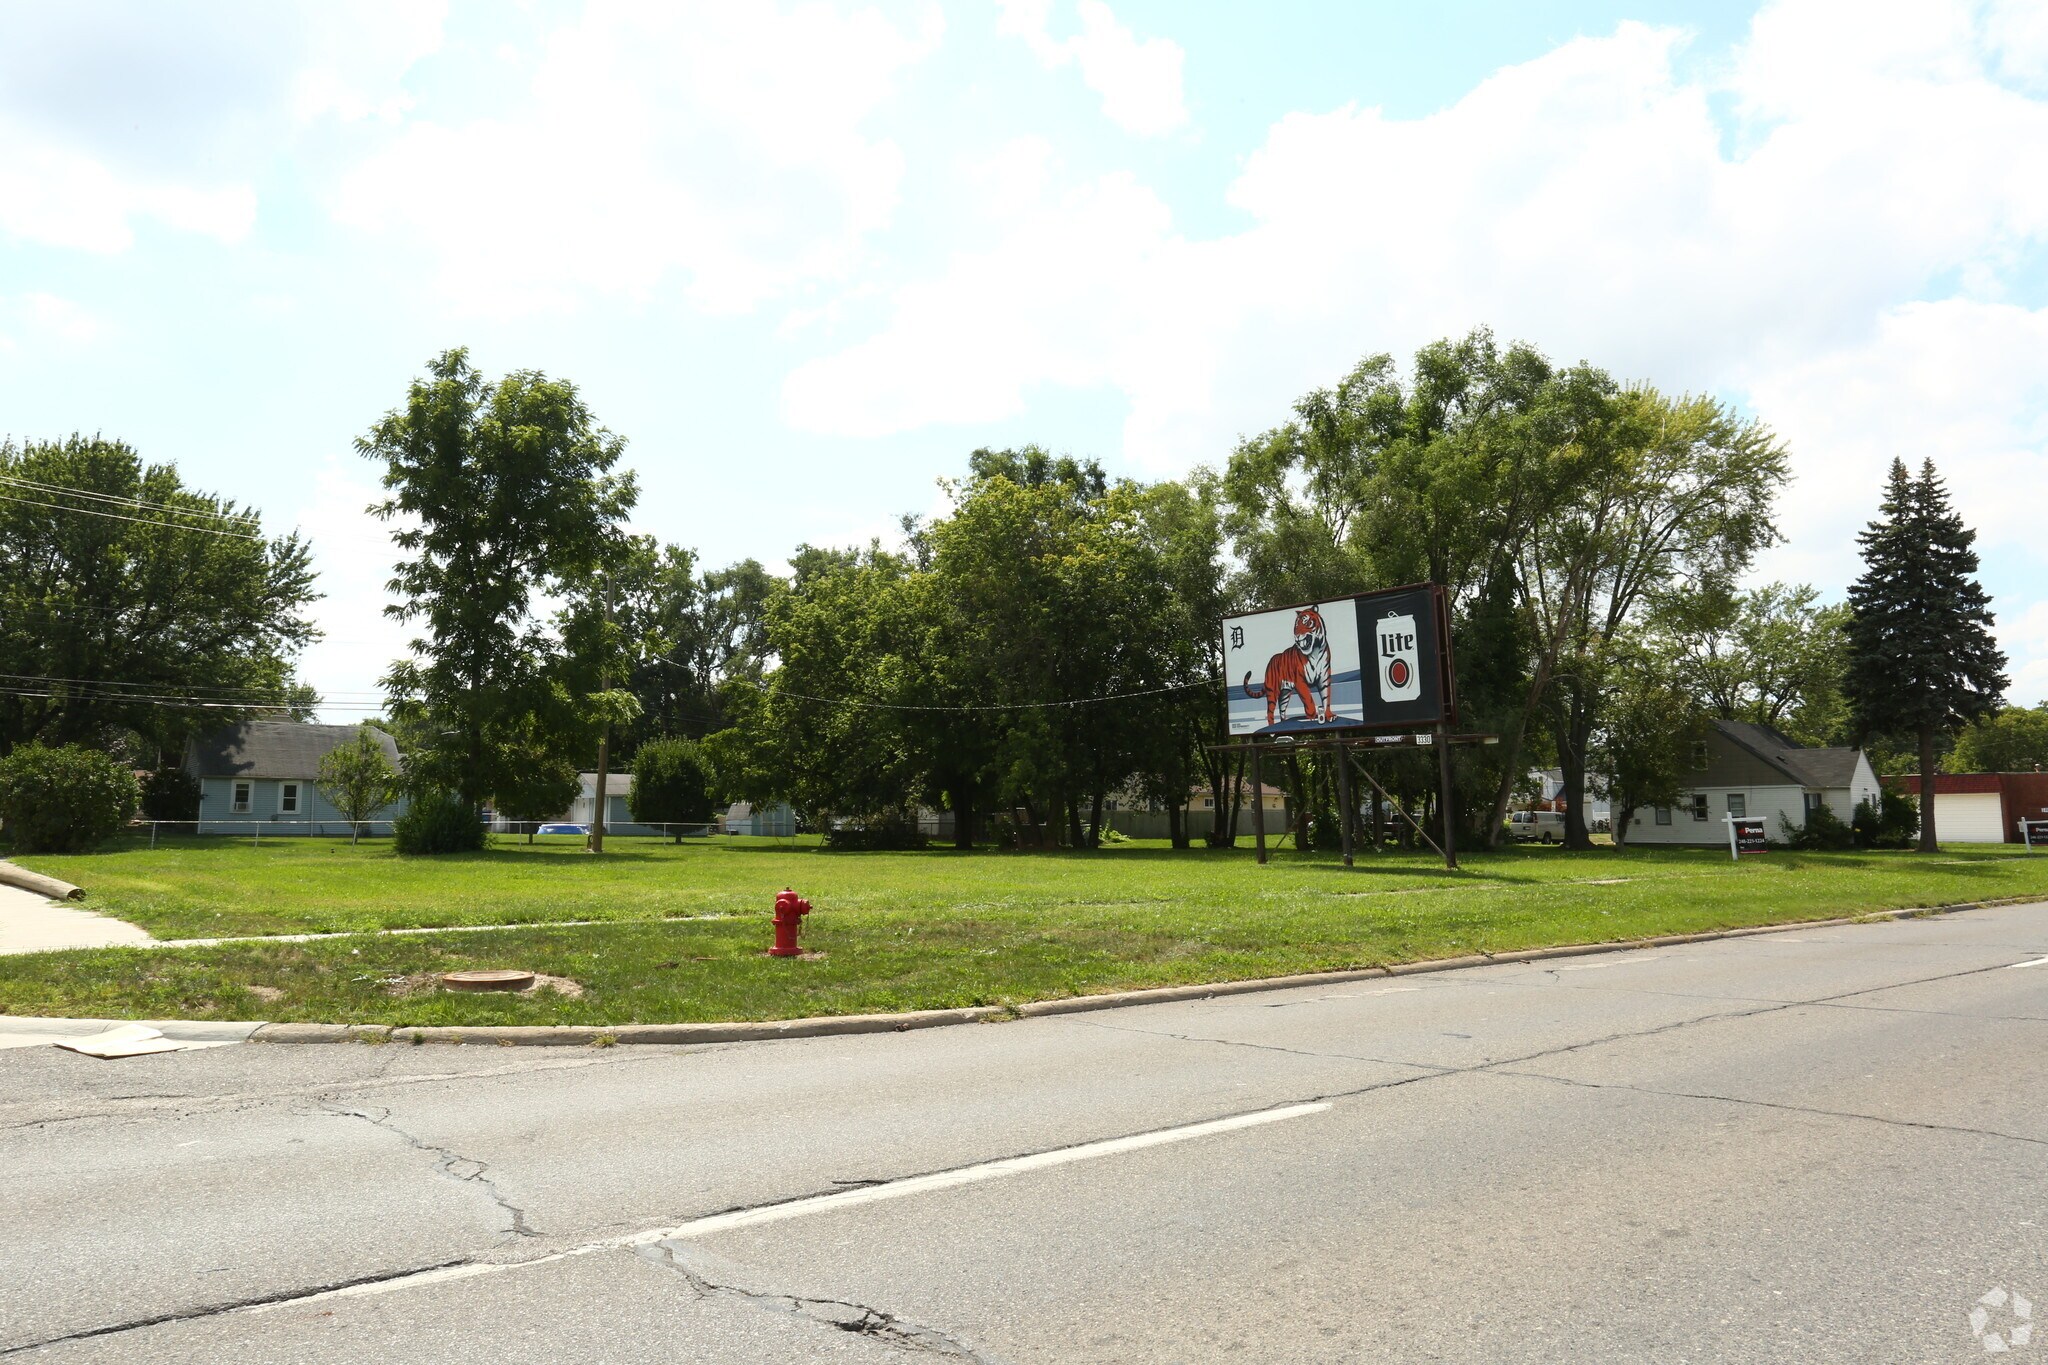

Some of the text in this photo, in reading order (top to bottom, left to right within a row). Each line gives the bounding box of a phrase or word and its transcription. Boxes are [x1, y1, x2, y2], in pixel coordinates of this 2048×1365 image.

[1230, 626, 1244, 651] D
[1380, 633, 1414, 658] Lite
[1417, 735, 1431, 744] 3330
